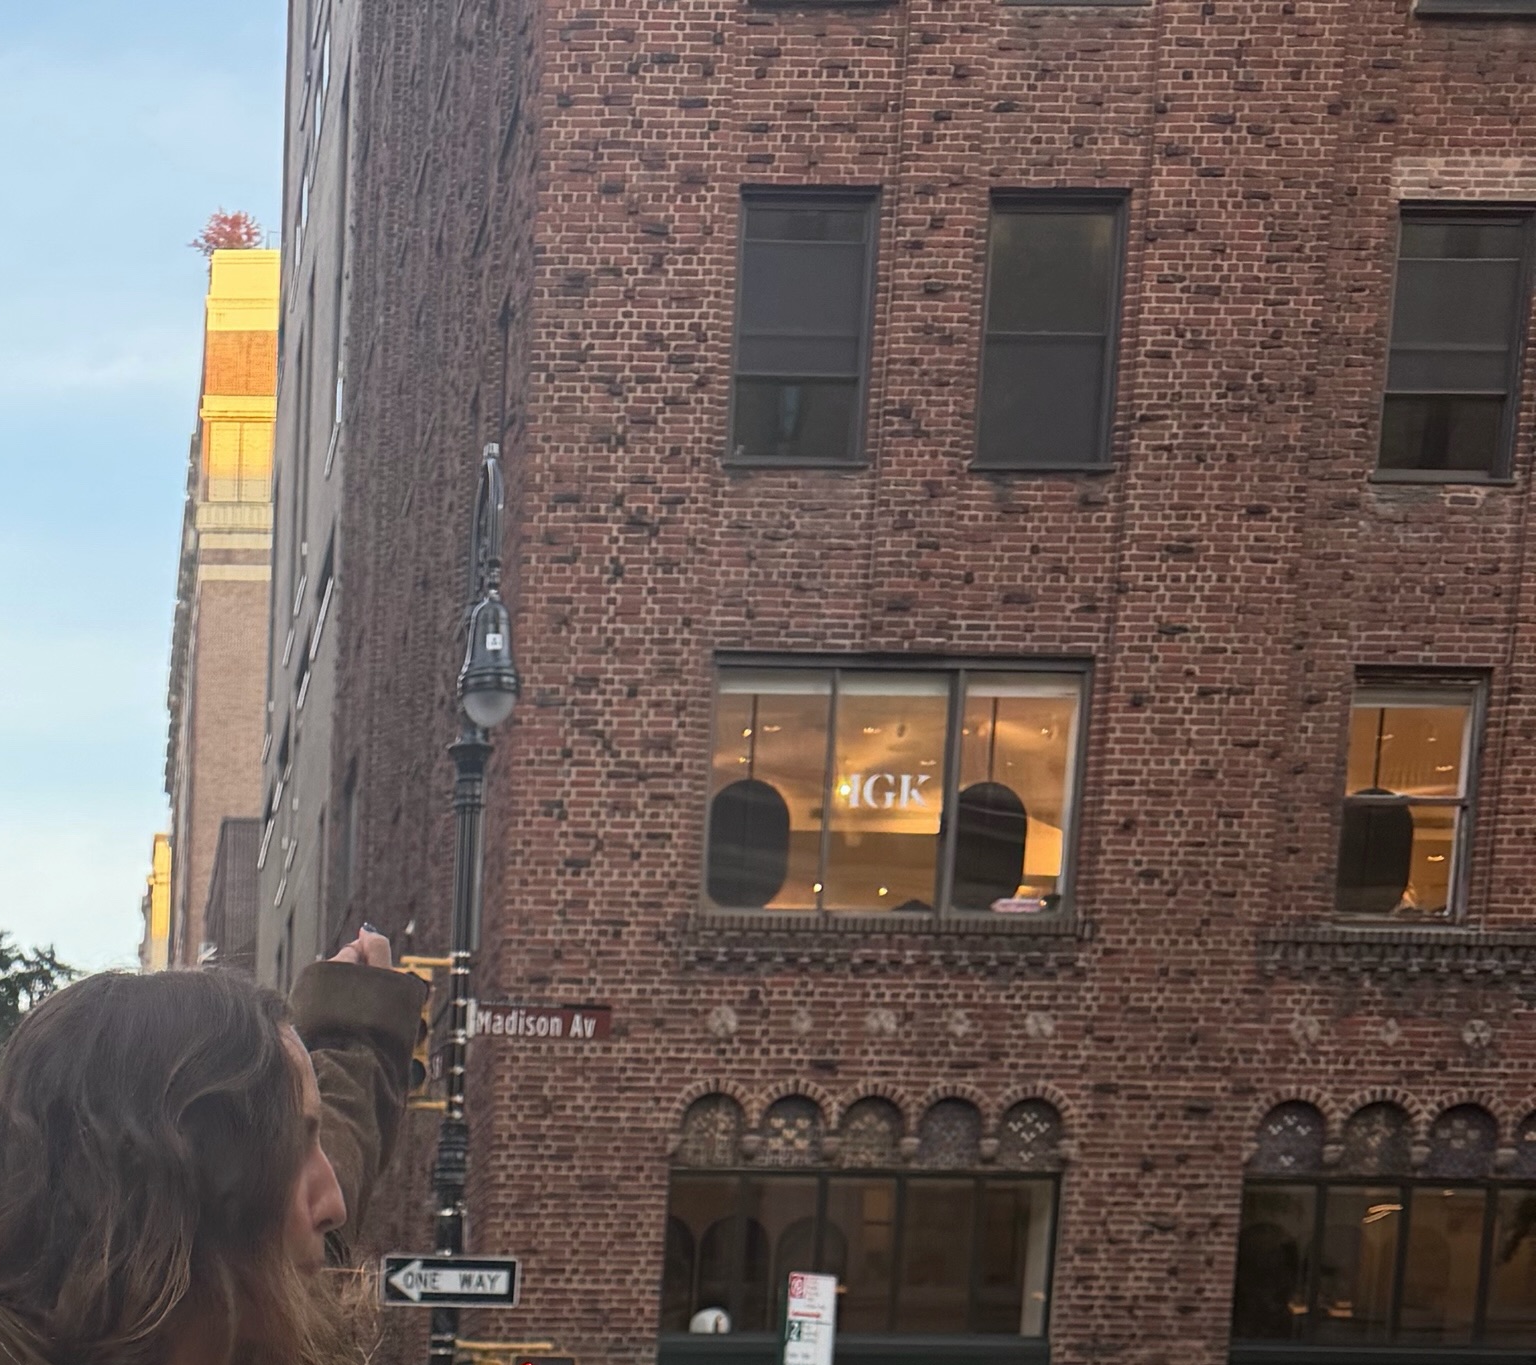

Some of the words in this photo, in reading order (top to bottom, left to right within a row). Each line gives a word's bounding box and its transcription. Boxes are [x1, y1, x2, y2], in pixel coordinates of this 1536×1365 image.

[848, 773, 932, 810] IGK
[476, 1008, 563, 1038] Madison
[569, 1013, 597, 1039] Av
[403, 1271, 440, 1291] ONE
[458, 1272, 502, 1292] WAY
